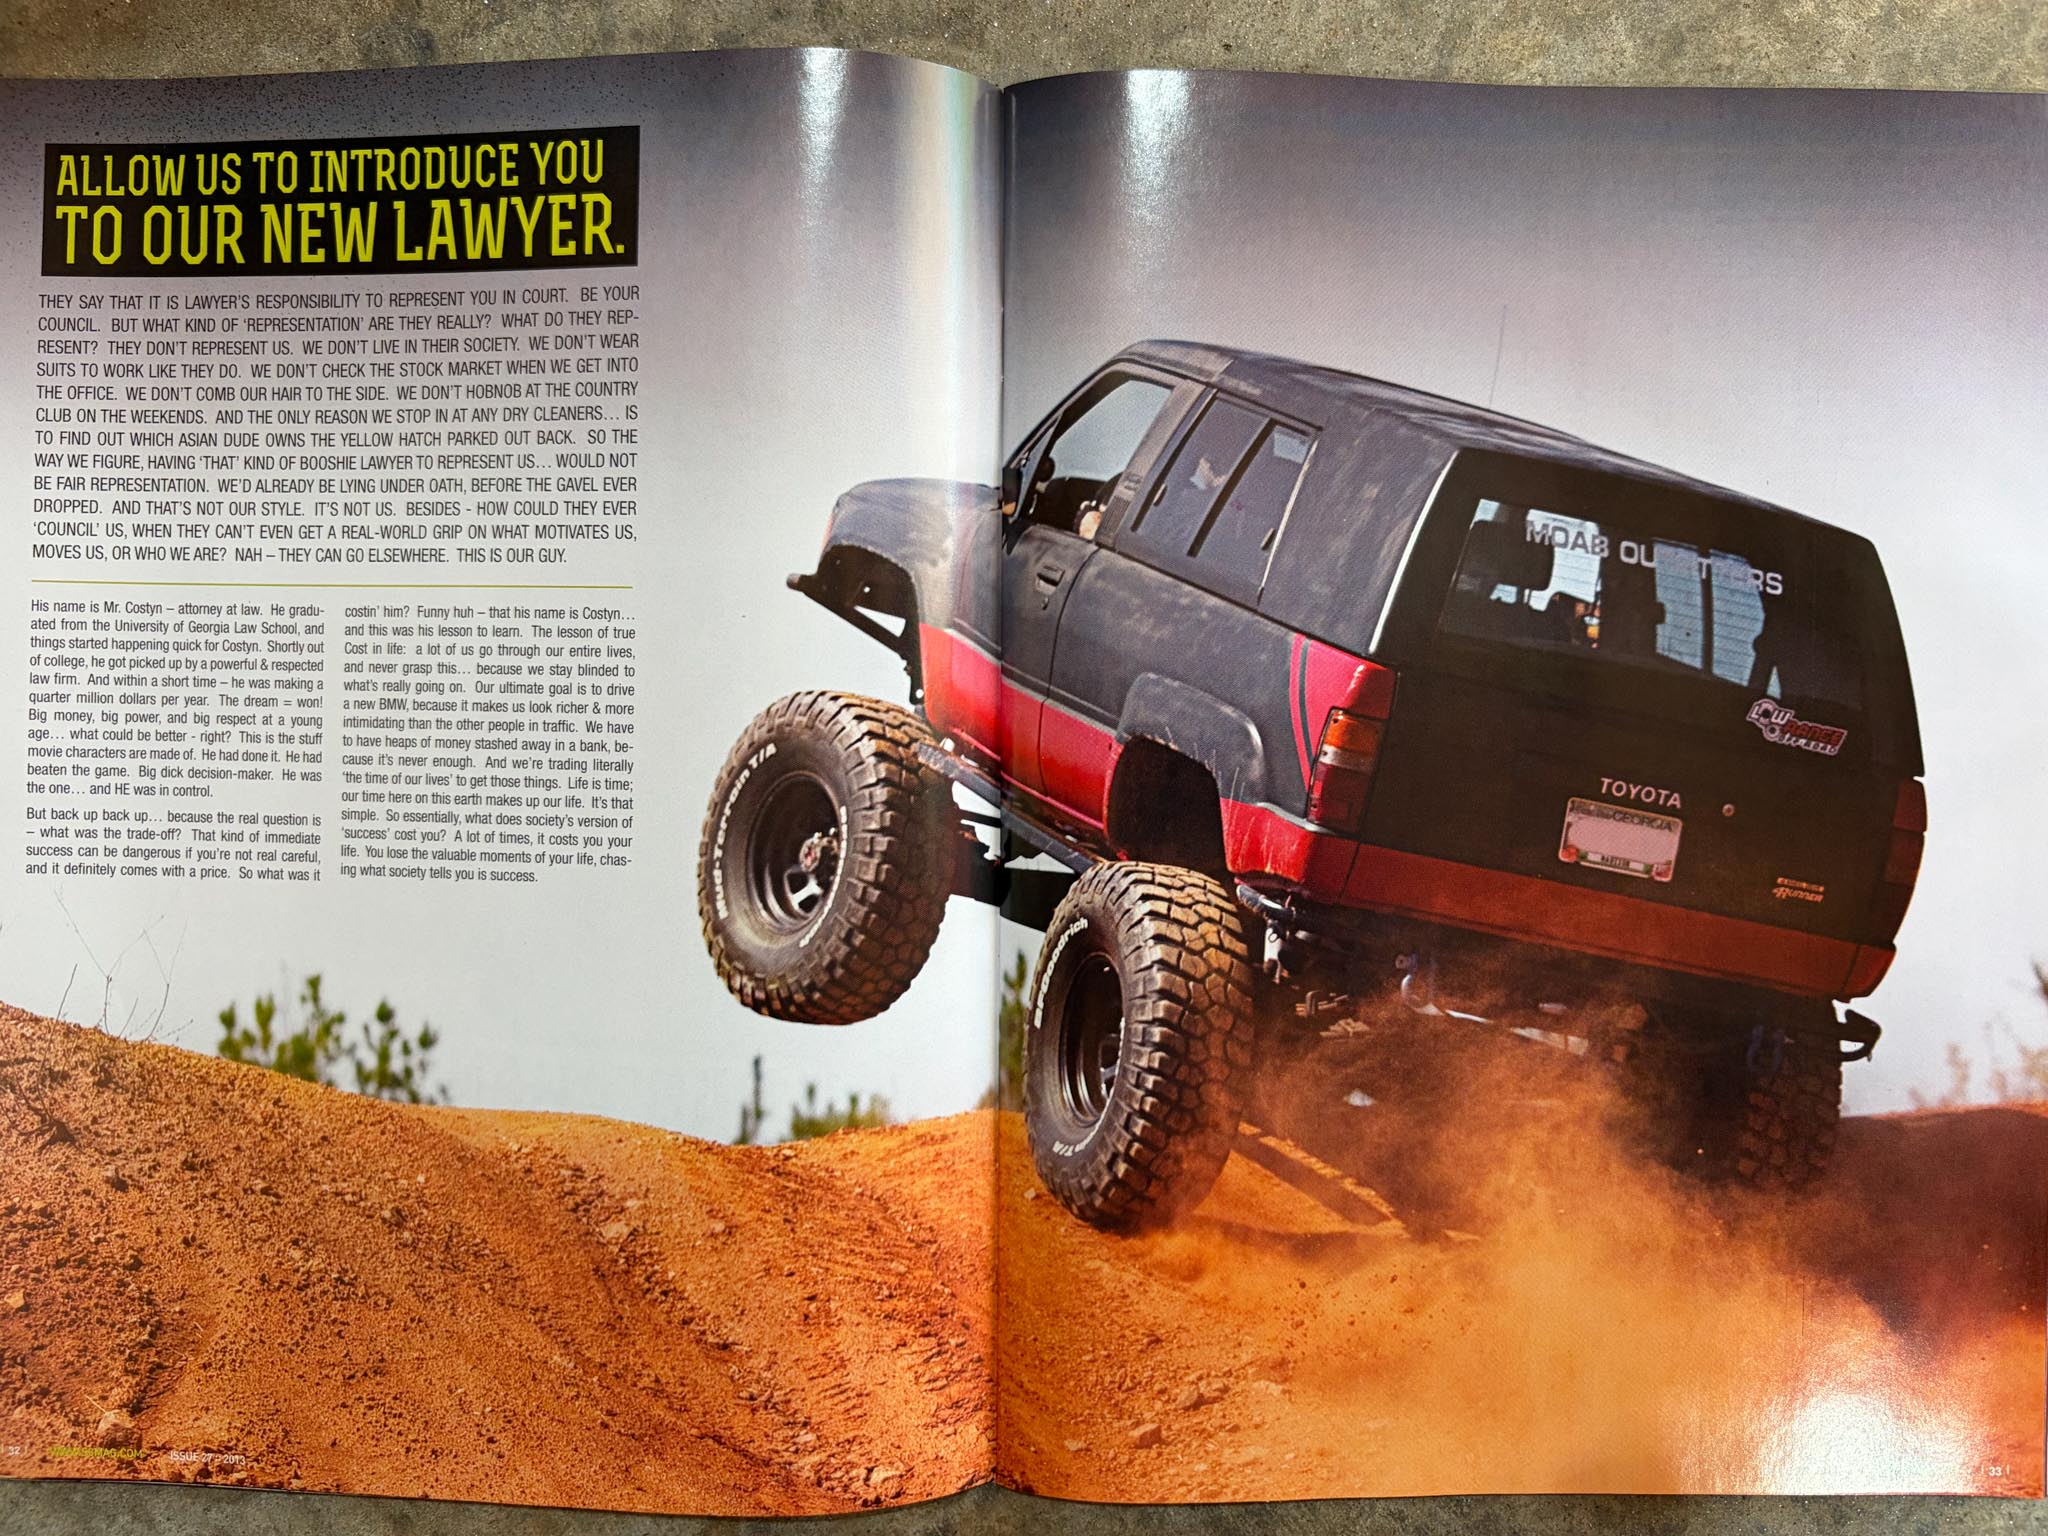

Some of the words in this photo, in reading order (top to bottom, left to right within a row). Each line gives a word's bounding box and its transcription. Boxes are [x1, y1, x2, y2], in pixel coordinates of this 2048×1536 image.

[57, 154, 186, 196] ALLOW
[195, 152, 242, 195] US
[252, 150, 298, 194] TO
[309, 143, 519, 193] INTRODUCE
[529, 139, 604, 185] YOU
[55, 205, 123, 265] TO
[143, 204, 245, 265] OUR
[260, 201, 378, 264] NEW
[393, 192, 625, 261] LAWYER.
[38, 294, 74, 309] THEY
[78, 294, 105, 310] SAY
[108, 295, 144, 310] THAT
[149, 295, 162, 310] IT
[166, 295, 179, 310] IS
[256, 293, 361, 309] RESPONSIBILITY
[365, 292, 383, 308] TO
[389, 291, 466, 308] REPRESENT
[470, 290, 497, 306] YOU
[503, 289, 516, 305] IN
[522, 287, 569, 304] COURT.
[580, 286, 598, 302] BE
[602, 284, 640, 301] YOUR
[36, 361, 76, 378] SUITS
[80, 362, 99, 378] TO
[103, 363, 144, 378] WORK
[149, 363, 177, 379] LIKE
[180, 363, 215, 379] THEY
[219, 363, 242, 379] DO.
[250, 363, 272, 378] WE
[322, 363, 366, 378] CHECK
[369, 362, 395, 378] THE
[399, 361, 444, 378] STOCK
[448, 360, 503, 376] MARKET
[506, 359, 546, 375] WHEN
[550, 358, 572, 374] WE
[576, 357, 603, 374] GET
[607, 356, 639, 373] INTO
[34, 430, 54, 445] TO
[59, 430, 91, 446] FIND
[97, 431, 126, 447] OUT
[129, 432, 174, 447] WHICH
[178, 432, 218, 447] ASIAN
[223, 432, 260, 448] DUDE
[265, 432, 306, 448] OWNS
[310, 432, 336, 448] THE
[340, 432, 394, 447] YELLOW
[399, 431, 442, 447] HATCH
[447, 430, 499, 446] PARKED
[504, 430, 532, 446] OUT
[536, 429, 576, 445] BACK.
[587, 429, 606, 445] SO
[611, 428, 638, 444] THE
[34, 475, 52, 490] BE
[56, 476, 86, 491] FAIR
[90, 476, 210, 493] REPRESENTATION.
[254, 478, 315, 494] ALREADY
[319, 478, 336, 494] BE
[340, 478, 376, 494] LYING
[380, 478, 425, 494] UNDER
[429, 478, 467, 495] OATH,
[471, 477, 523, 493] BEFORE
[525, 477, 552, 492] THE
[556, 476, 599, 492] GAVEL
[603, 476, 637, 492] EVER
[1526, 520, 1610, 558] MOAB
[30, 617, 56, 630] ated
[60, 617, 88, 631] from
[92, 619, 111, 632] the
[115, 619, 170, 635] University
[173, 620, 185, 633] of
[188, 620, 230, 636] Georgia
[234, 621, 258, 634] Law
[261, 621, 301, 636] School,
[304, 622, 325, 635] and
[344, 623, 365, 636] and
[368, 623, 388, 637] this
[391, 626, 414, 637] was
[418, 624, 434, 637] his
[438, 624, 473, 637] lesson
[476, 624, 488, 638] to
[492, 624, 523, 638] learn.
[531, 624, 553, 638] The
[557, 625, 593, 639] lesson
[597, 625, 609, 639] of
[613, 626, 636, 640] true
[30, 635, 66, 651] things
[68, 637, 109, 650] started
[111, 637, 170, 654] happening
[172, 639, 202, 654] quick
[204, 639, 220, 652] for
[222, 639, 262, 655] Costyn.
[267, 639, 305, 656] Shortly
[307, 641, 325, 654] out
[344, 641, 368, 655] Cost
[372, 644, 382, 655] in
[387, 642, 406, 655] life:
[415, 645, 423, 656] a
[427, 643, 441, 656] lot
[445, 642, 457, 656] of
[461, 645, 474, 656] us
[479, 645, 493, 659] go
[497, 643, 541, 660] through
[545, 646, 565, 657] our
[569, 645, 602, 658] entire
[606, 645, 636, 660] lives,
[28, 708, 47, 724] Big
[53, 711, 95, 725] money,
[101, 710, 119, 725] big
[124, 712, 162, 725] power,
[167, 711, 188, 724] and
[193, 711, 210, 727] big
[216, 713, 257, 728] respect
[261, 713, 273, 726] at
[278, 715, 285, 726] a
[290, 716, 323, 730] young
[748, 743, 777, 769] T/A
[1600, 777, 1681, 809] TOYOTA
[25, 862, 48, 875] and
[52, 862, 60, 875] it
[63, 862, 117, 878] definitely
[120, 865, 158, 877] comes
[161, 865, 185, 877] with
[189, 867, 197, 878] a
[200, 867, 231, 881] price.
[238, 866, 253, 880] So
[256, 867, 284, 881] what
[287, 870, 310, 881] was
[313, 868, 321, 882] it
[340, 862, 357, 879] ing
[359, 863, 387, 877] what
[388, 866, 427, 881] society
[429, 866, 452, 880] tells
[455, 869, 475, 882] you
[477, 870, 487, 881] is
[490, 870, 538, 883] success.
[8, 1446, 20, 1456] 32
[170, 1449, 199, 1462] ISSUE
[201, 1452, 213, 1464] 27
[1988, 1466, 2002, 1477] 33
